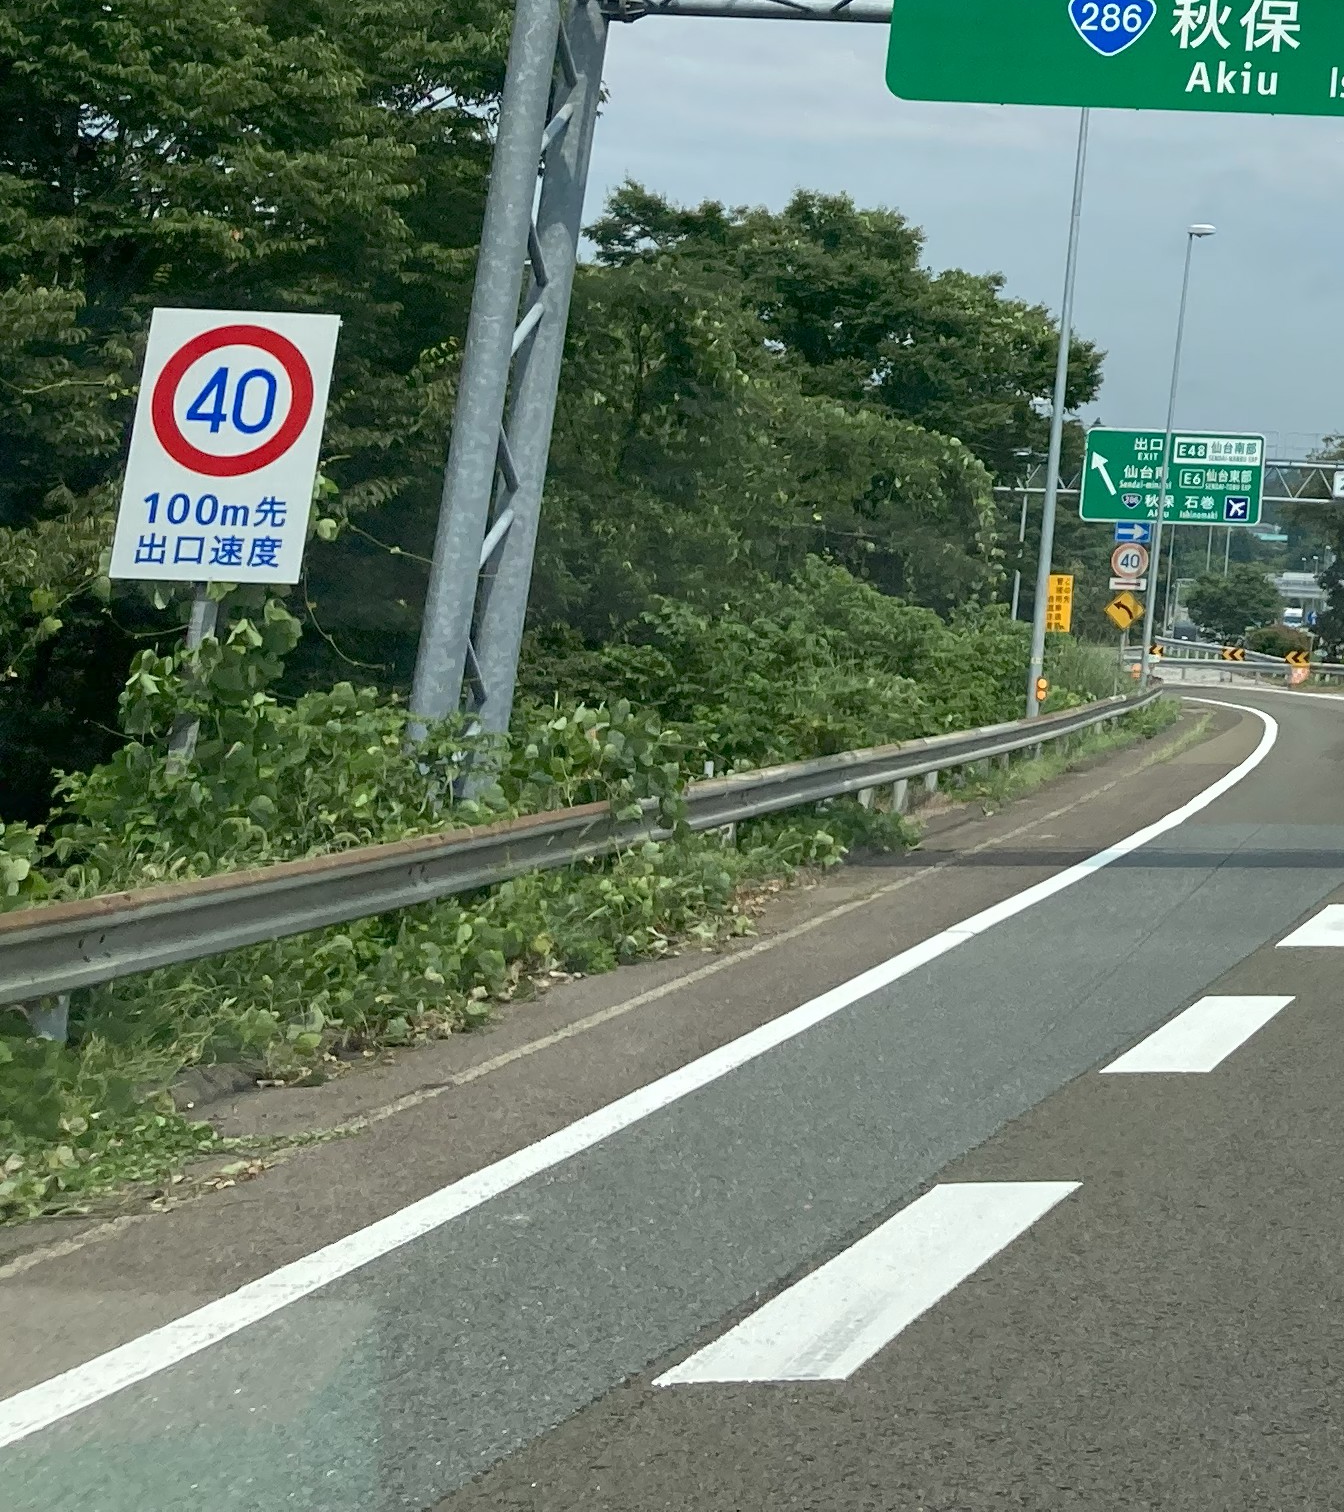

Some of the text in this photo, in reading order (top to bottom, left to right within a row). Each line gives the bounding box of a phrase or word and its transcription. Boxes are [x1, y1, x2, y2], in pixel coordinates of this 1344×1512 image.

[1080, 0, 1144, 34] 286
[1185, 61, 1279, 98] Akiu
[185, 366, 278, 435] 40
[1133, 437, 1164, 452] 出口
[1178, 443, 1207, 458] E48
[1211, 440, 1258, 455] 仙台南部
[1137, 452, 1159, 462] EXIT
[1183, 472, 1201, 485] E6
[1206, 469, 1253, 484] 仙台東部
[143, 492, 287, 528] 100m先
[1184, 495, 1215, 510] 石巻
[1147, 509, 1170, 519] Aku
[134, 533, 283, 568] 出口速度
[1120, 553, 1141, 569] 40
